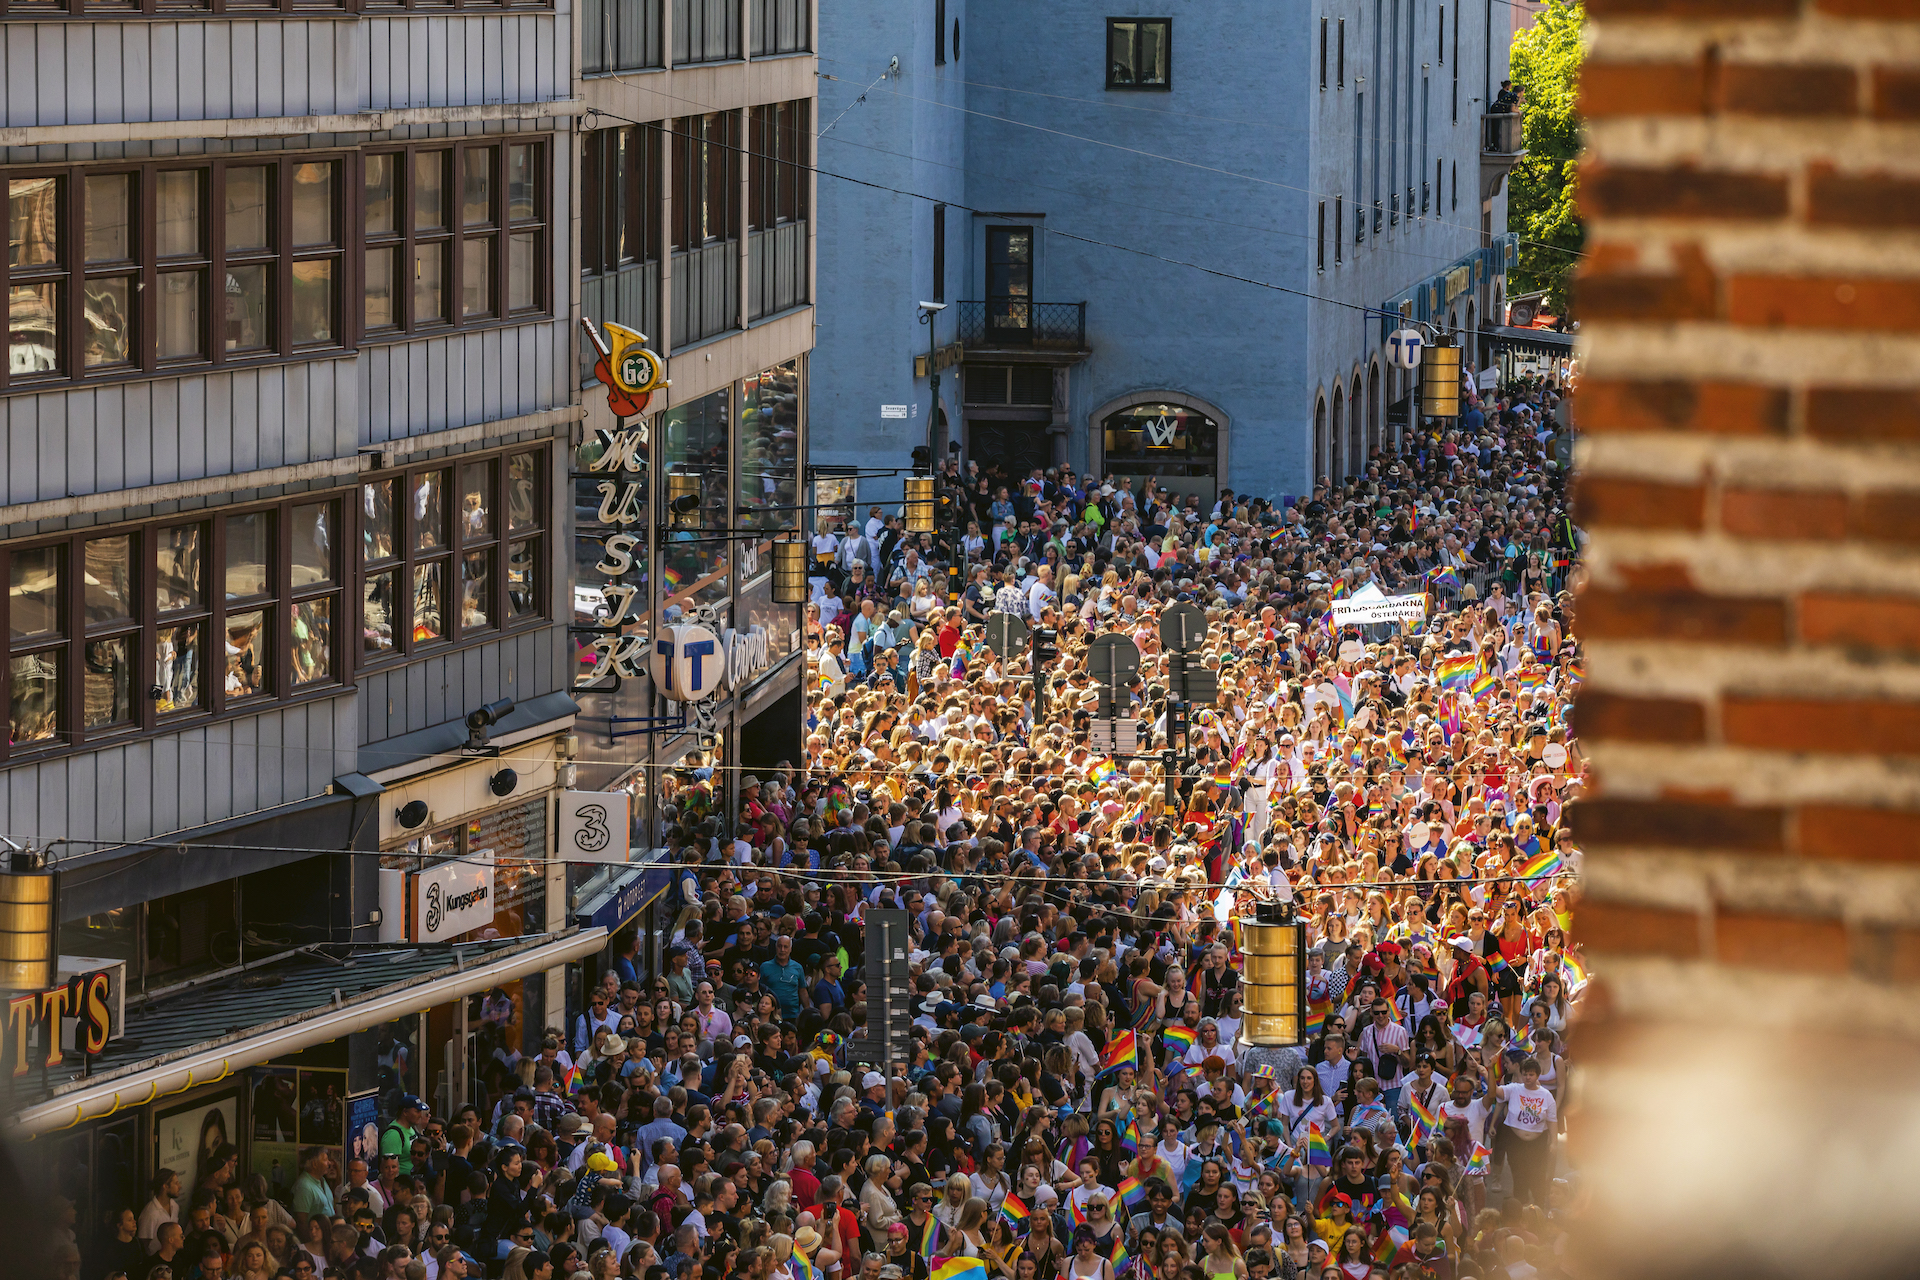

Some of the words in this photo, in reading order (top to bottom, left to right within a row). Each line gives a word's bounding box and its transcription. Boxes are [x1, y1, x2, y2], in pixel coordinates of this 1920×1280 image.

[1406, 339, 1420, 363] T
[684, 640, 714, 692] T
[723, 624, 768, 692] Cervera
[574, 803, 611, 852] 3
[426, 882, 441, 932] 3
[446, 885, 488, 913] Kungsgatan
[0, 972, 111, 1078] TT'S
